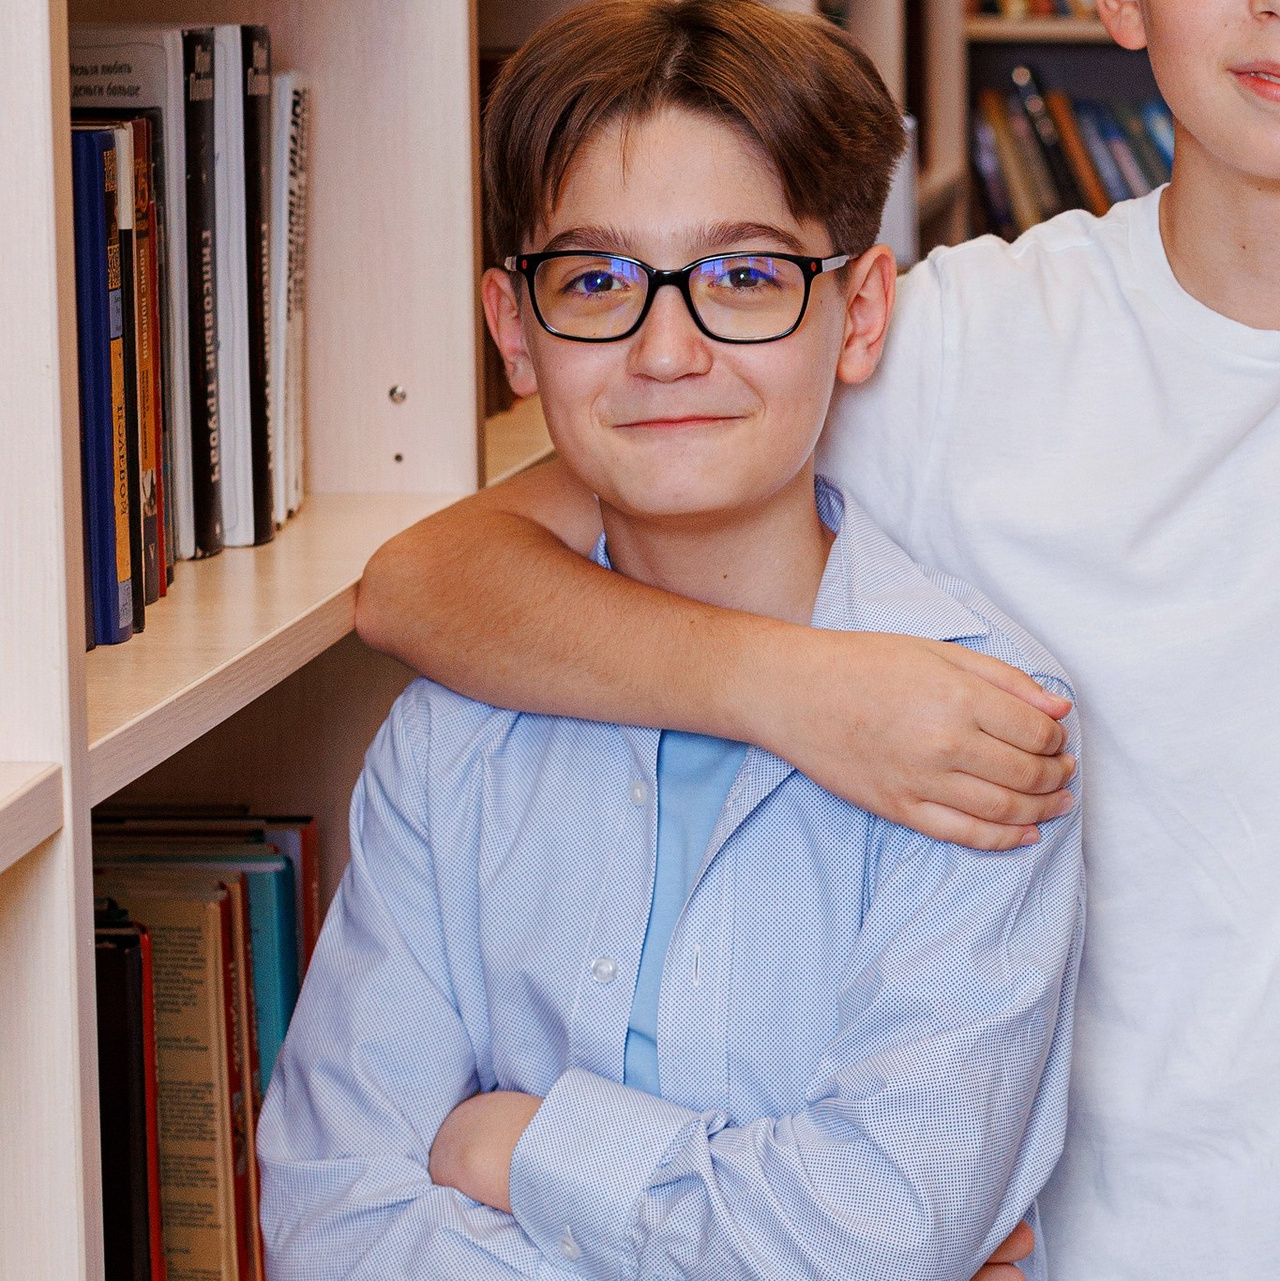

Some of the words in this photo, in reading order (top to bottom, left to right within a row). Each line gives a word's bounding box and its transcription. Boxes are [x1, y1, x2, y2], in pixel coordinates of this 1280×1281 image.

[201, 228, 217, 373] Гипсовый
[116, 405, 129, 516] ПОЛЕВОЙ
[206, 378, 221, 484] трубач
